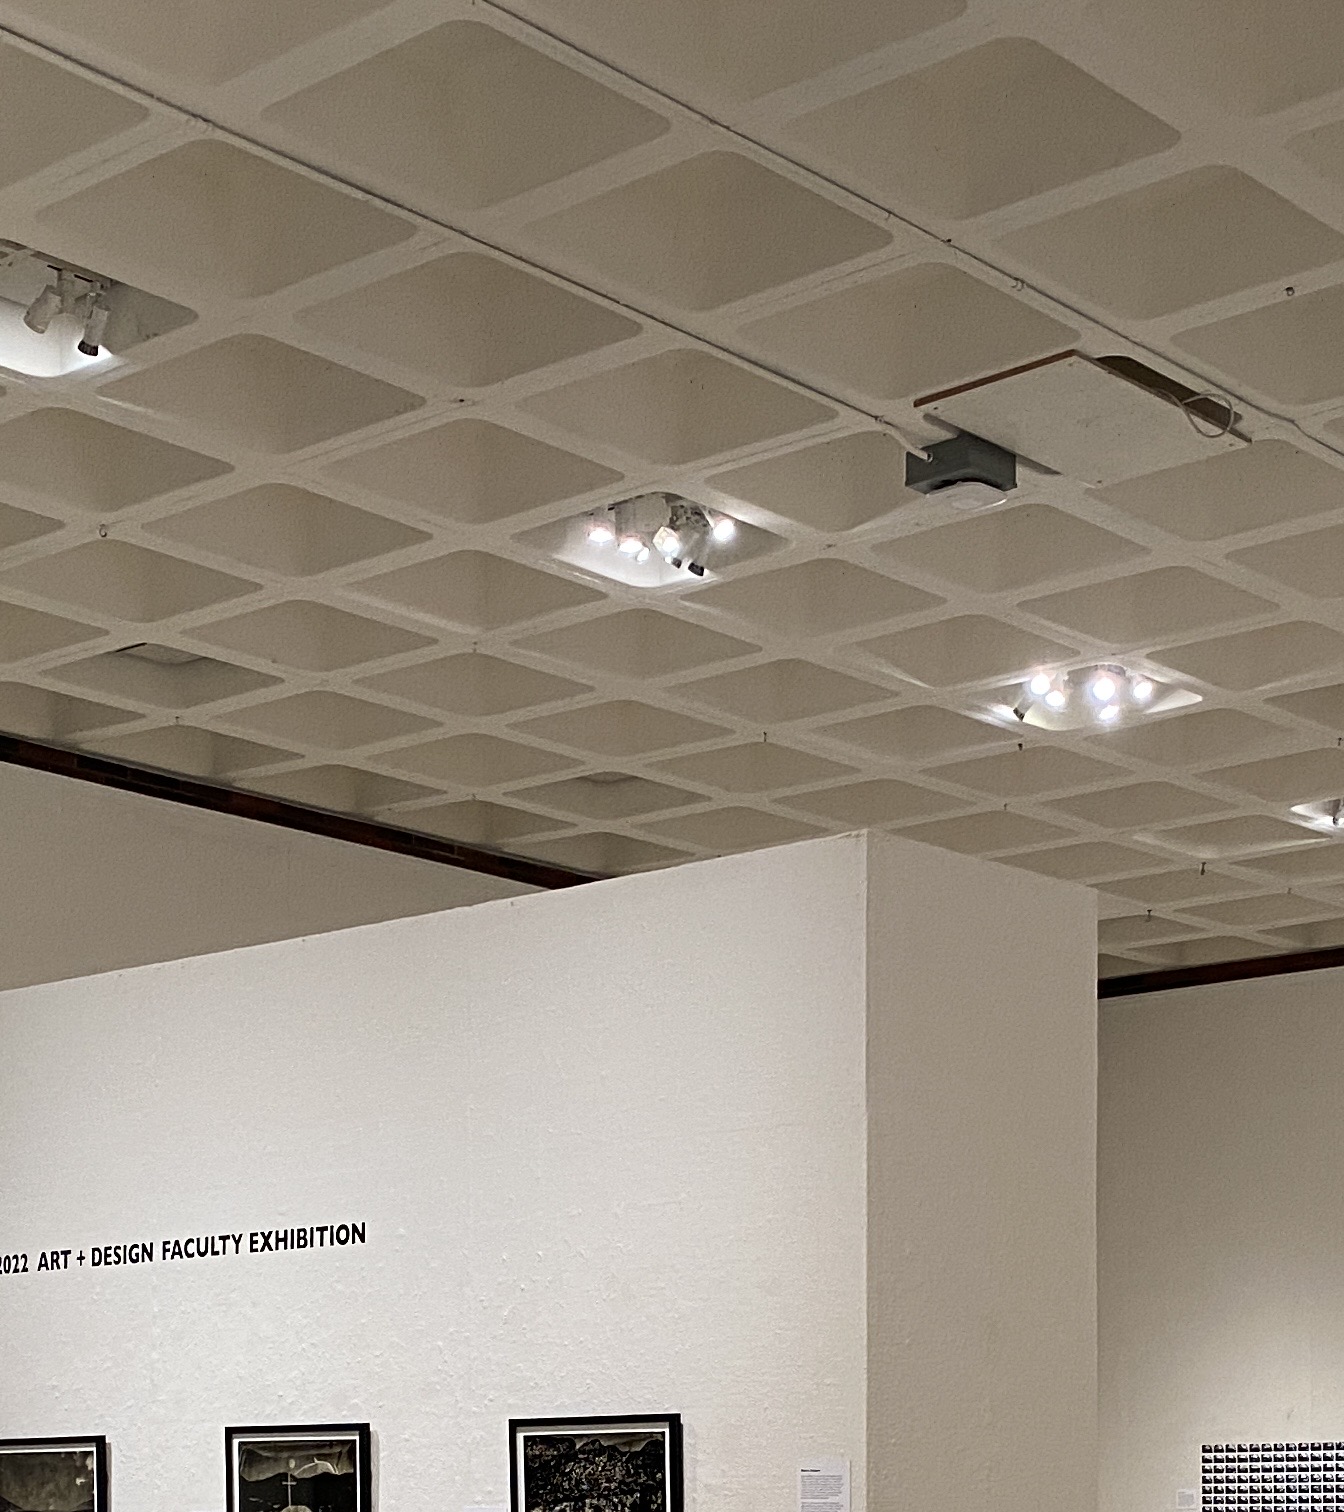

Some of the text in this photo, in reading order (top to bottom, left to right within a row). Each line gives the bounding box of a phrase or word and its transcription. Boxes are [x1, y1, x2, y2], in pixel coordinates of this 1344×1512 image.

[37, 1249, 72, 1272] ART
[77, 1250, 86, 1267] +
[91, 1242, 154, 1267] DESIGN
[162, 1233, 243, 1261] FACULTY
[249, 1222, 366, 1253] EXHIBITION
